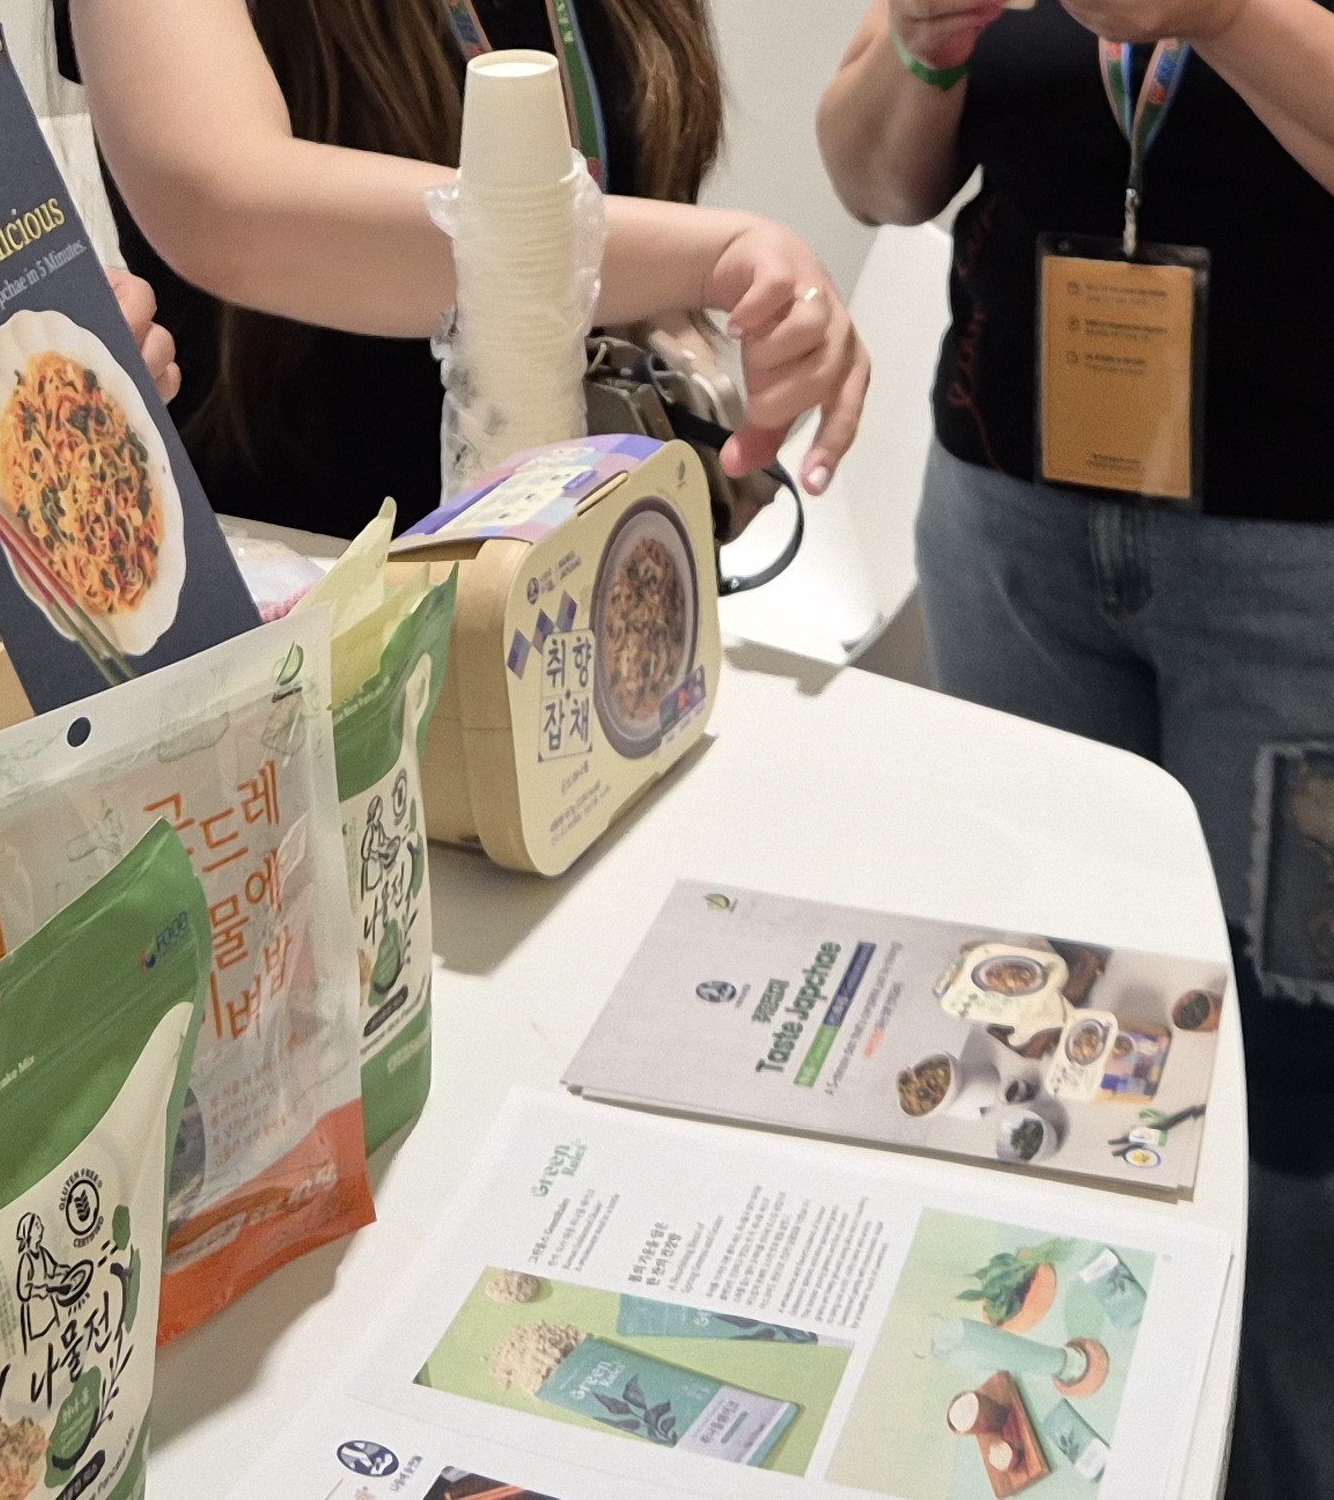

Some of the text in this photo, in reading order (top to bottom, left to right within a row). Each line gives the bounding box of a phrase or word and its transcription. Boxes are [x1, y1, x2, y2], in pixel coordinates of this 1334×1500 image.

[546, 635, 593, 689] 취향
[543, 696, 591, 752] 잡채
[755, 1021, 804, 1073] Taste
[784, 941, 842, 1021] Japchae
[17, 1054, 36, 1075] Mix
